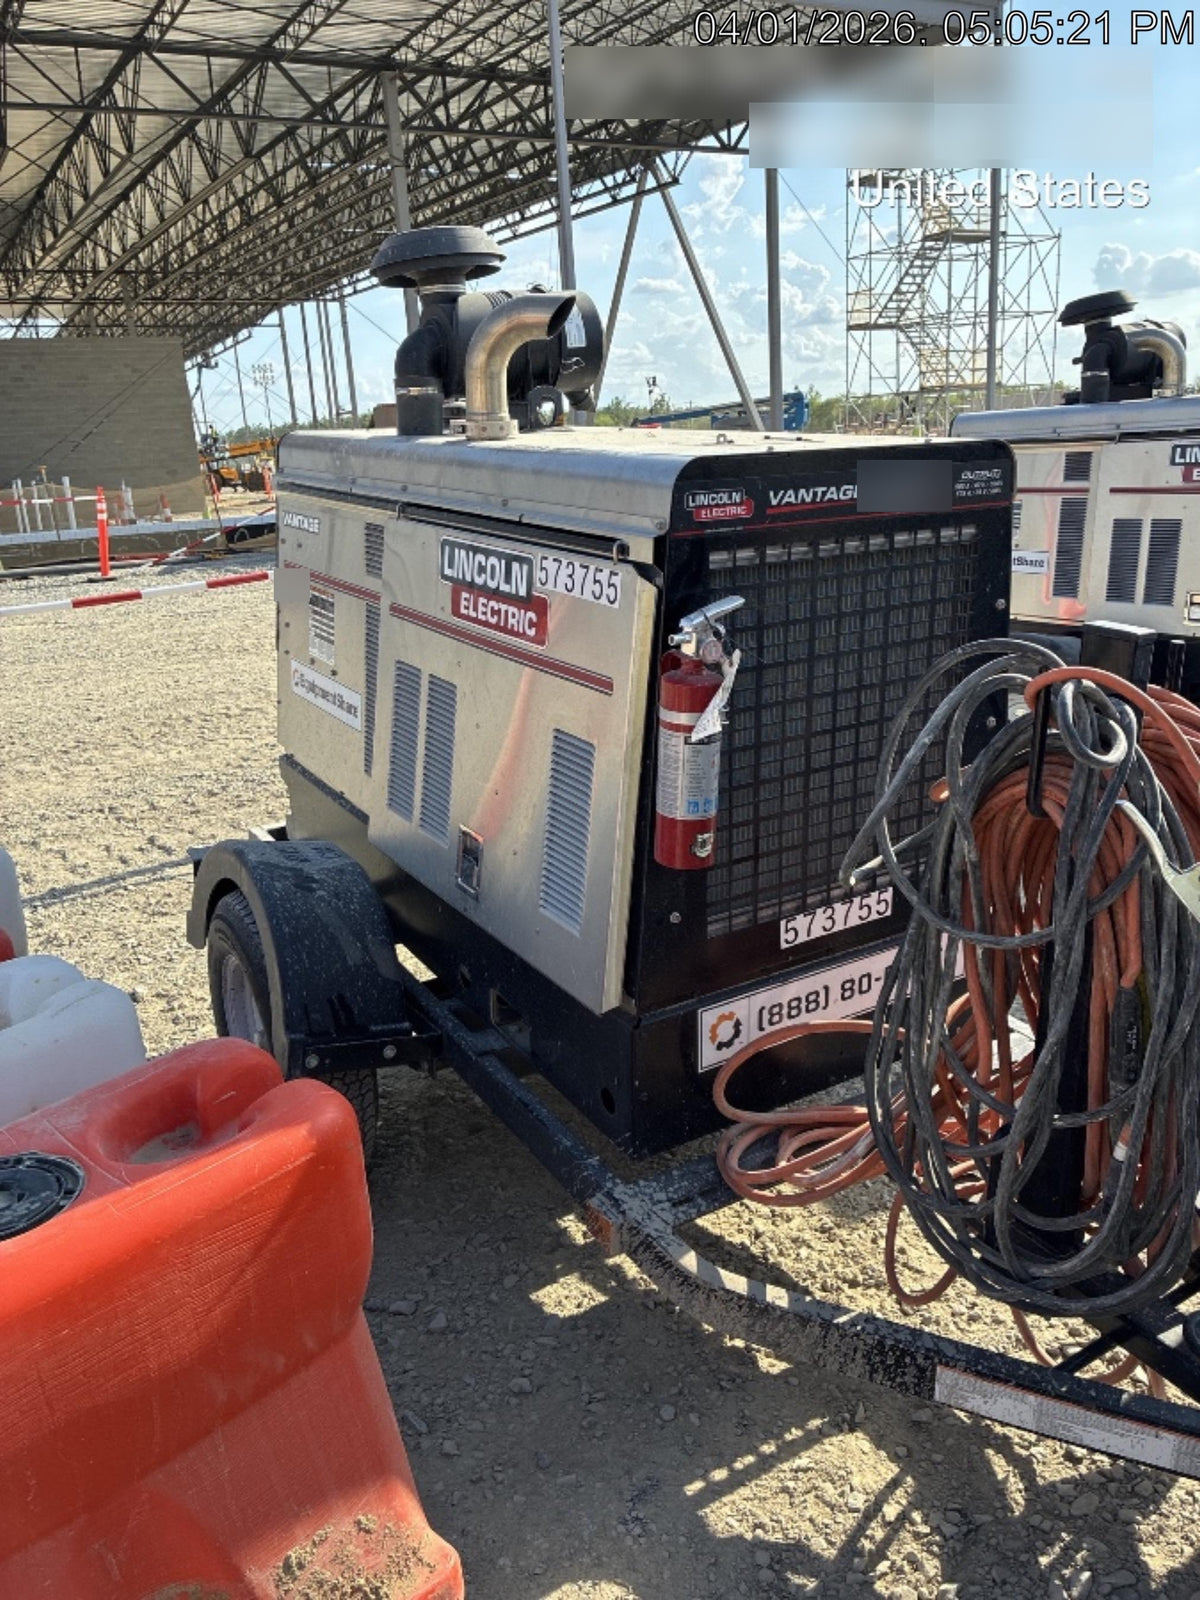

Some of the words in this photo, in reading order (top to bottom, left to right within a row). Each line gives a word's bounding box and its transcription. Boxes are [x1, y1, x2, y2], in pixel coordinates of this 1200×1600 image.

[282, 511, 321, 534] VANTAGE
[688, 491, 742, 508] LINCOLN
[701, 505, 747, 519] ELECTRIC
[443, 544, 530, 598] LINCOLN
[537, 555, 620, 606] 573755
[459, 591, 538, 638] ELECTRIC
[300, 672, 358, 720] EquipmentShare
[783, 889, 891, 946] 573755
[757, 984, 830, 1032] (888)
[840, 966, 894, 1002] 80-
